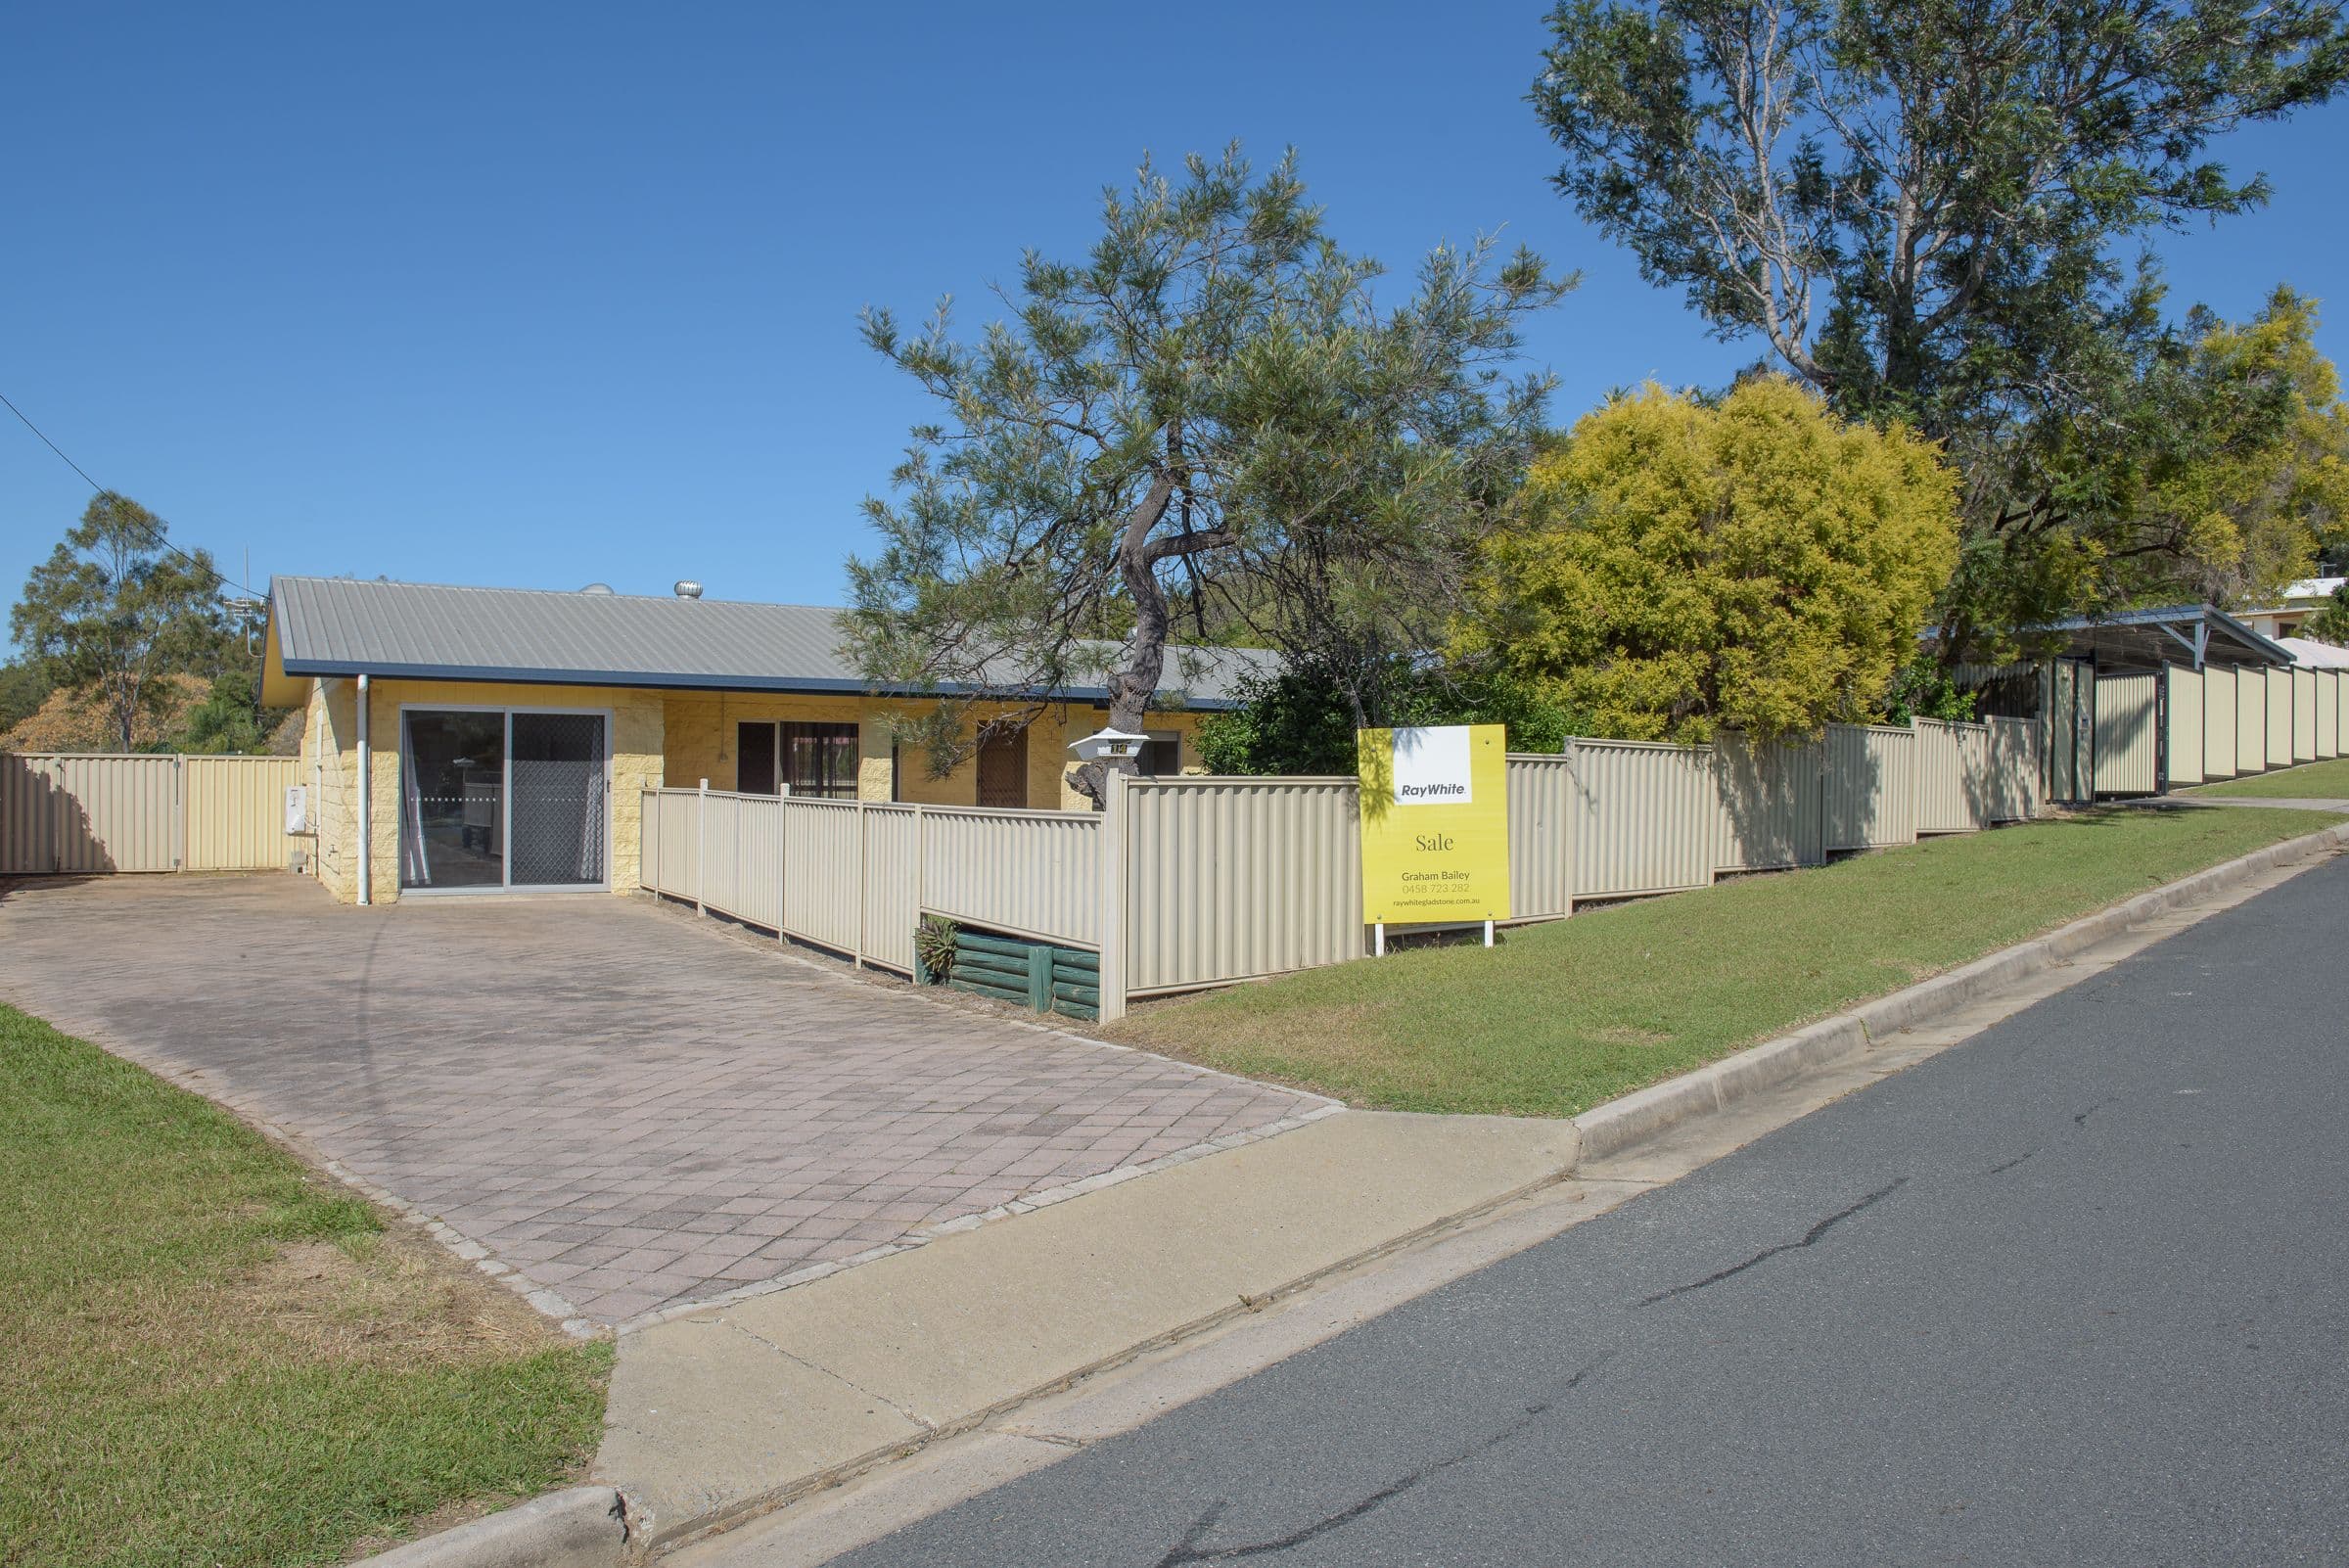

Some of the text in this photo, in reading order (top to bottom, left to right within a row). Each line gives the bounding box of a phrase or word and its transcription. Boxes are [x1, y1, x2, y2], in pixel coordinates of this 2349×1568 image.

[1415, 833, 1454, 852] Sale
[1402, 870, 1470, 882] Graham Bailey
[1402, 883, 1470, 895] 0458 723 282
[1393, 898, 1480, 907] raywhitegladstone.com.au
